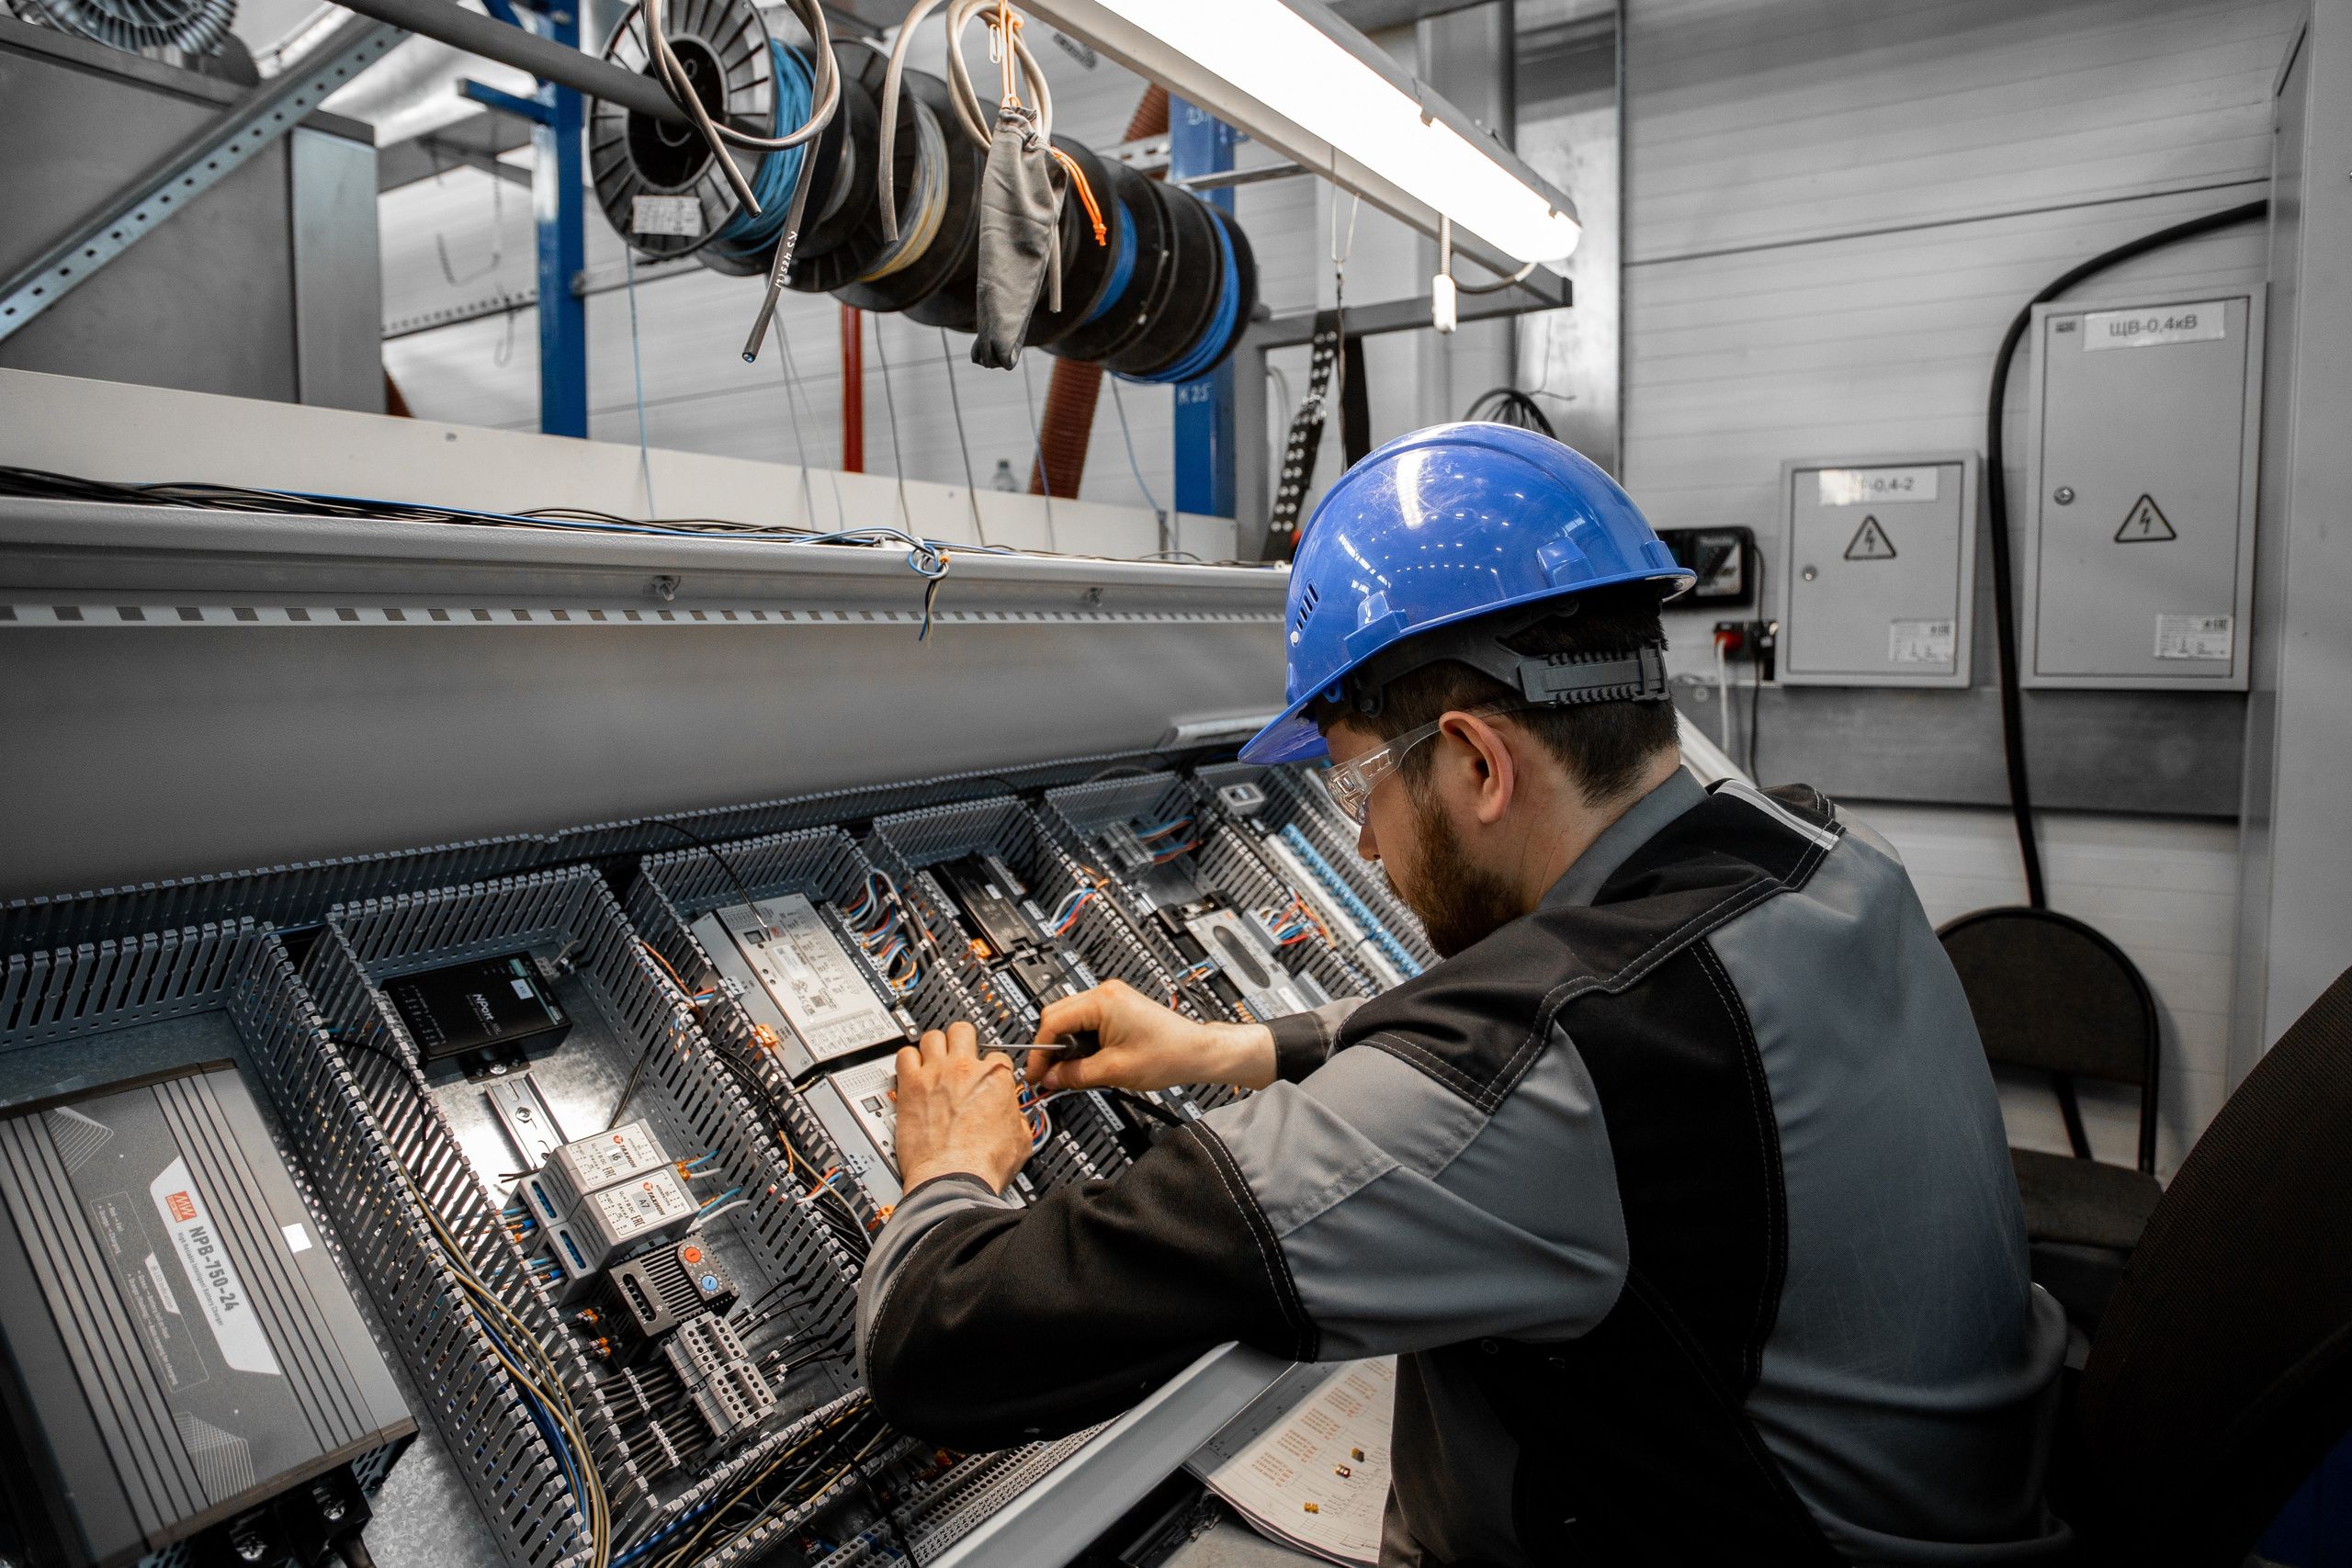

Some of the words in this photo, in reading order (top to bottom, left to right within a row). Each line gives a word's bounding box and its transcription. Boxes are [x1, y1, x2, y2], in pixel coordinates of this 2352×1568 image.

[471, 993, 494, 1020] NPort
[638, 1199, 650, 1208] A7
[153, 1270, 164, 1282] LED
[176, 1231, 187, 1244] High
[182, 1242, 195, 1264] Reliable
[190, 1262, 207, 1289] Intelligent
[201, 1287, 214, 1306] Battery
[209, 1305, 223, 1325] Charger
[187, 1224, 240, 1312] NPB-750-24
